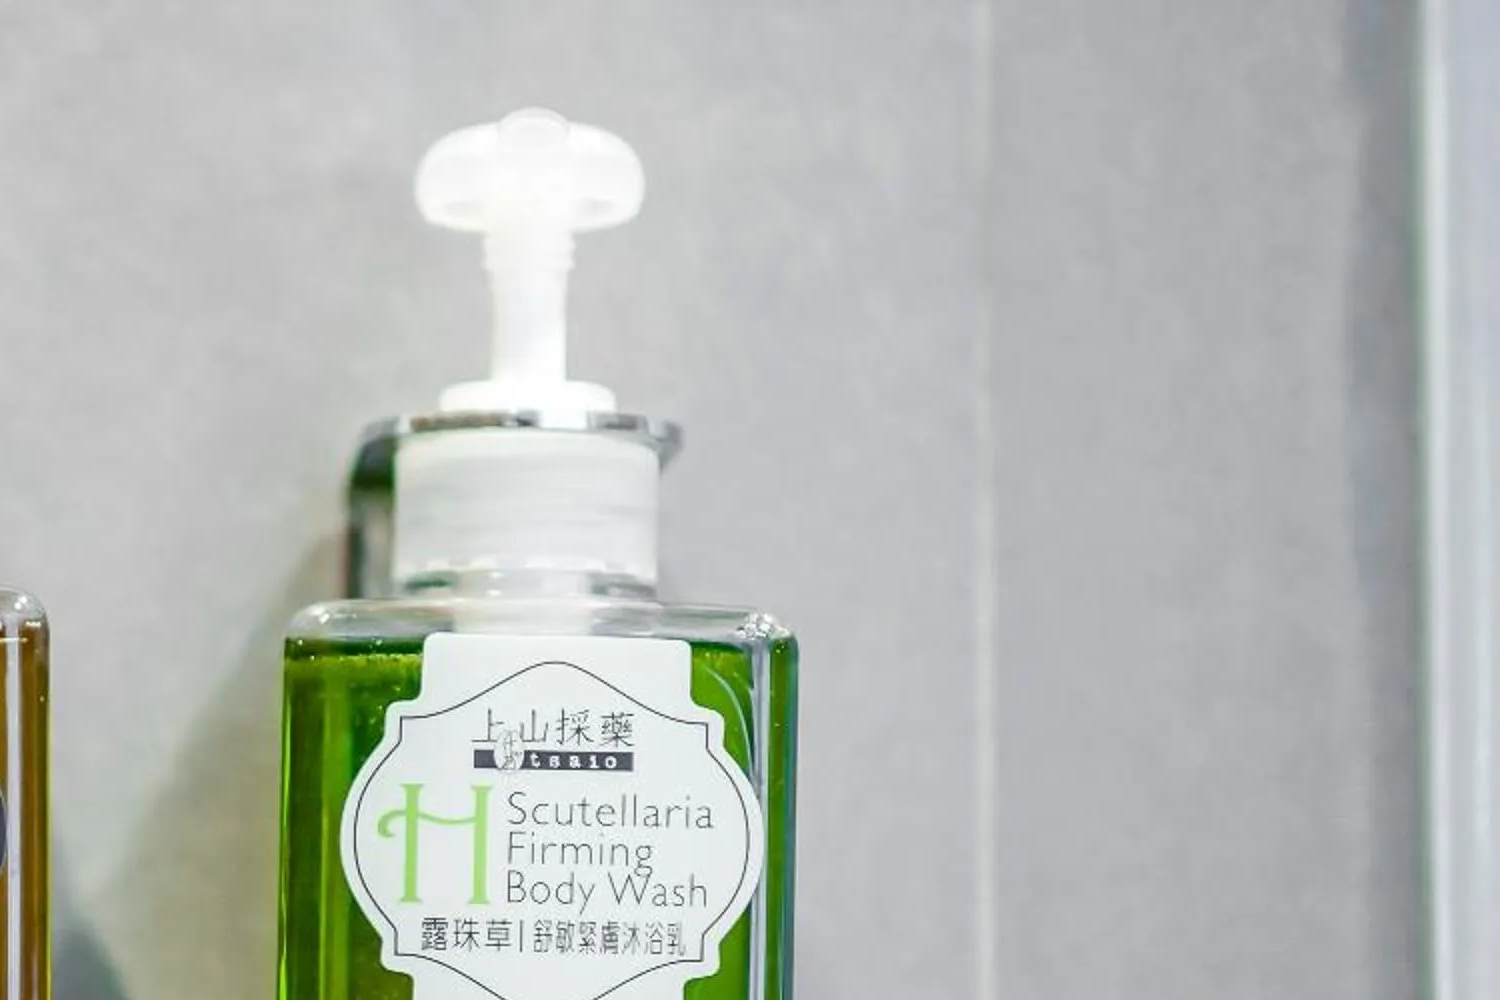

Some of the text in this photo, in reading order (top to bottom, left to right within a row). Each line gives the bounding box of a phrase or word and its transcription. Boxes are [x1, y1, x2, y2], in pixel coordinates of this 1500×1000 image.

[472, 708, 636, 748] 上山採藥
[530, 753, 618, 769] tsaio
[508, 792, 715, 829] Scutellaria
[377, 783, 494, 906] H
[507, 831, 653, 876] Firming
[507, 870, 708, 915] Body Wash
